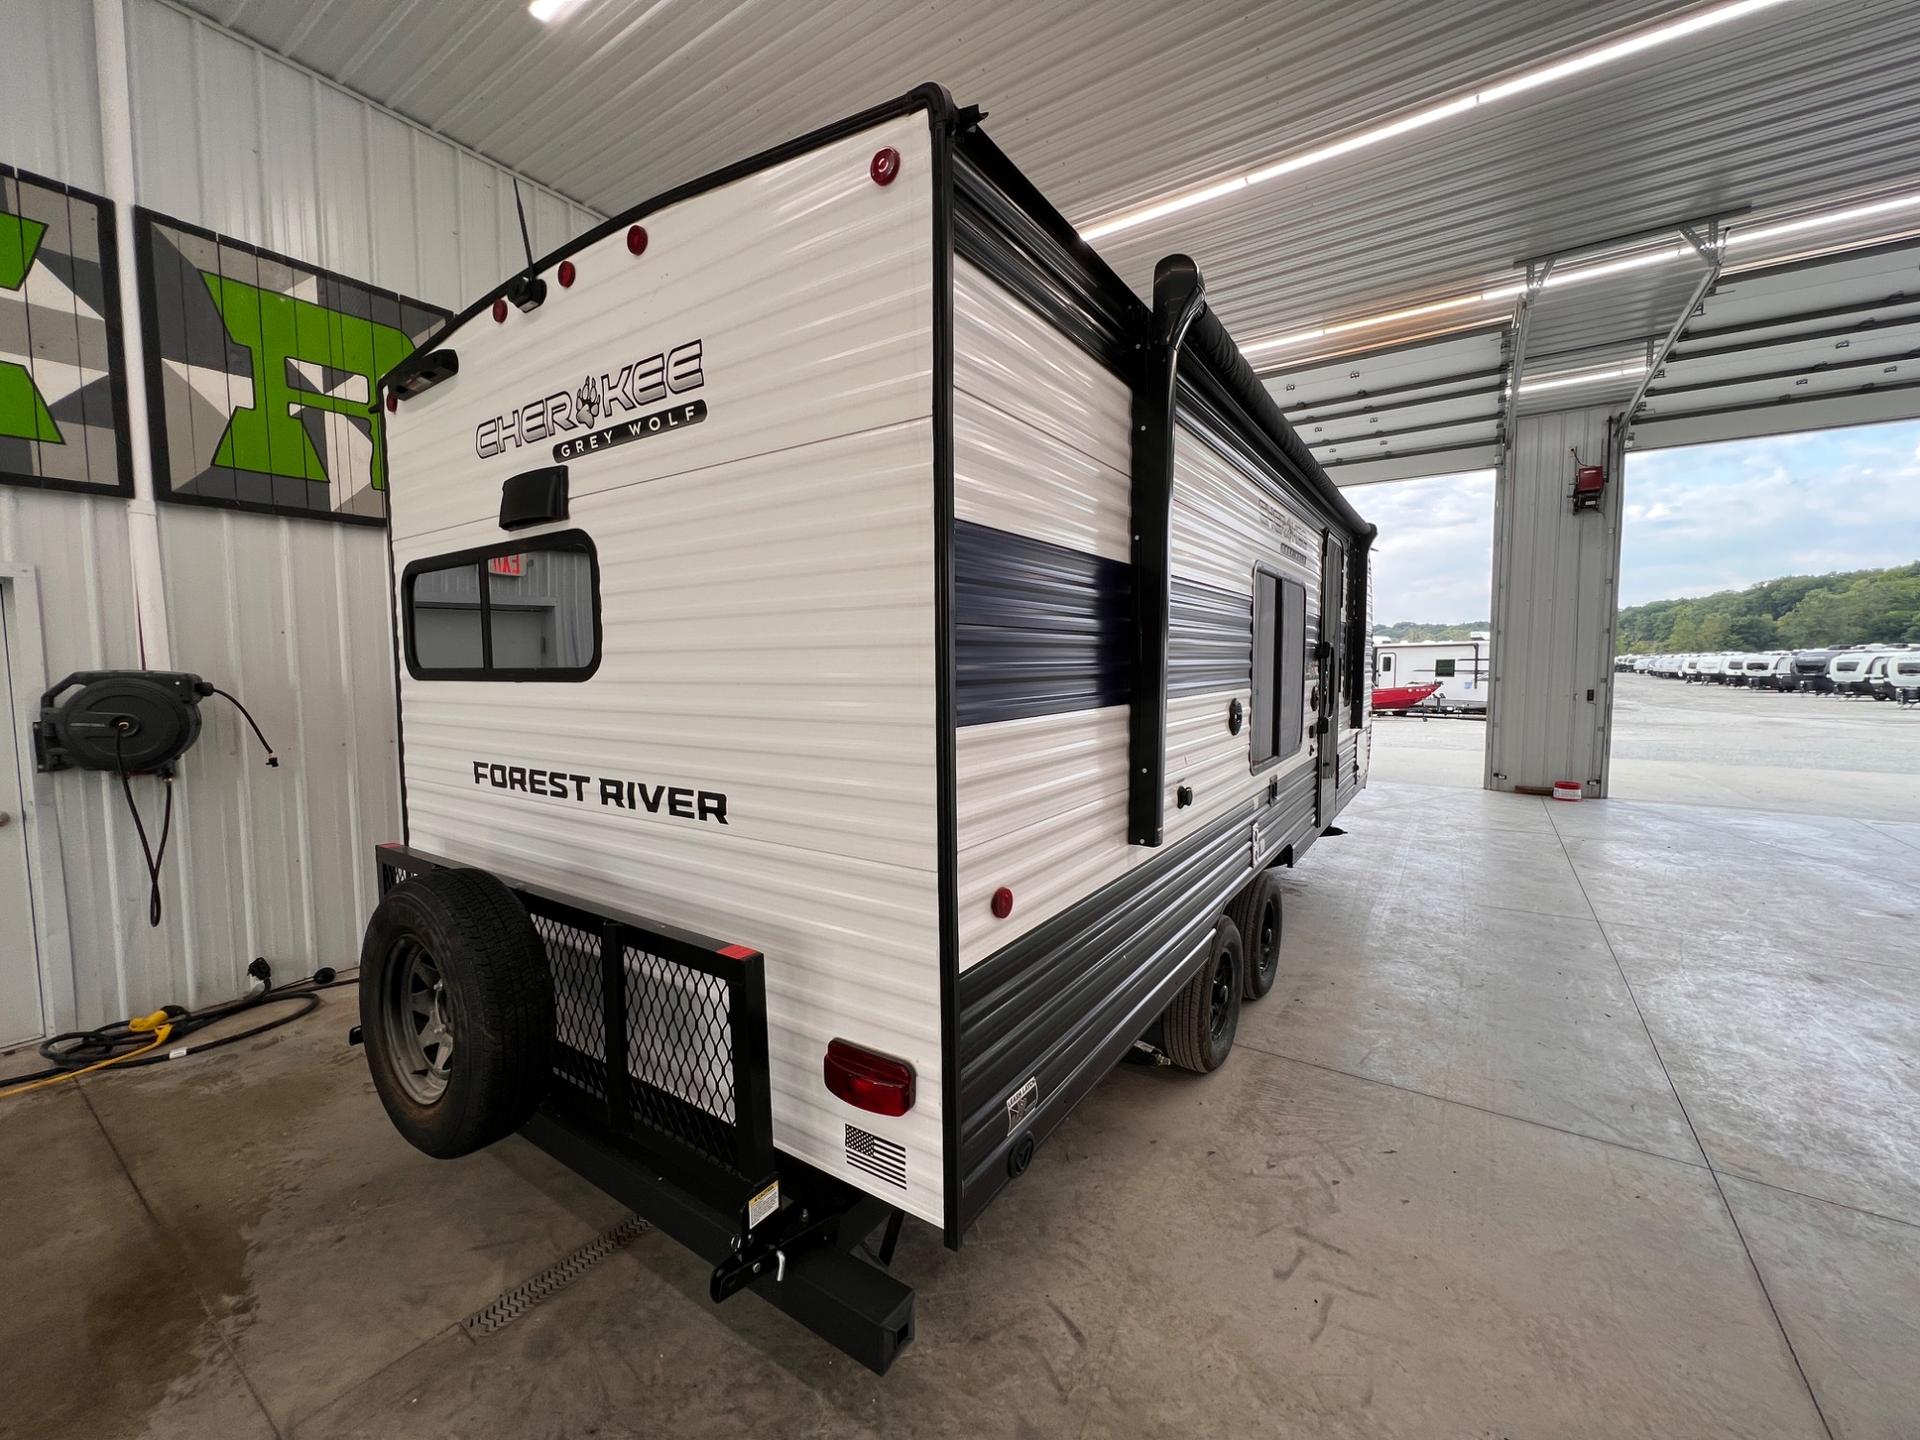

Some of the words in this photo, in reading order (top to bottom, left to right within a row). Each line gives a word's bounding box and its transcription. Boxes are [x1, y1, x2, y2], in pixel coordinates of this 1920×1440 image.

[560, 430, 614, 458] GREY
[628, 405, 696, 437] WOLF
[473, 761, 591, 802] FOREST
[599, 777, 729, 825] RIVER
